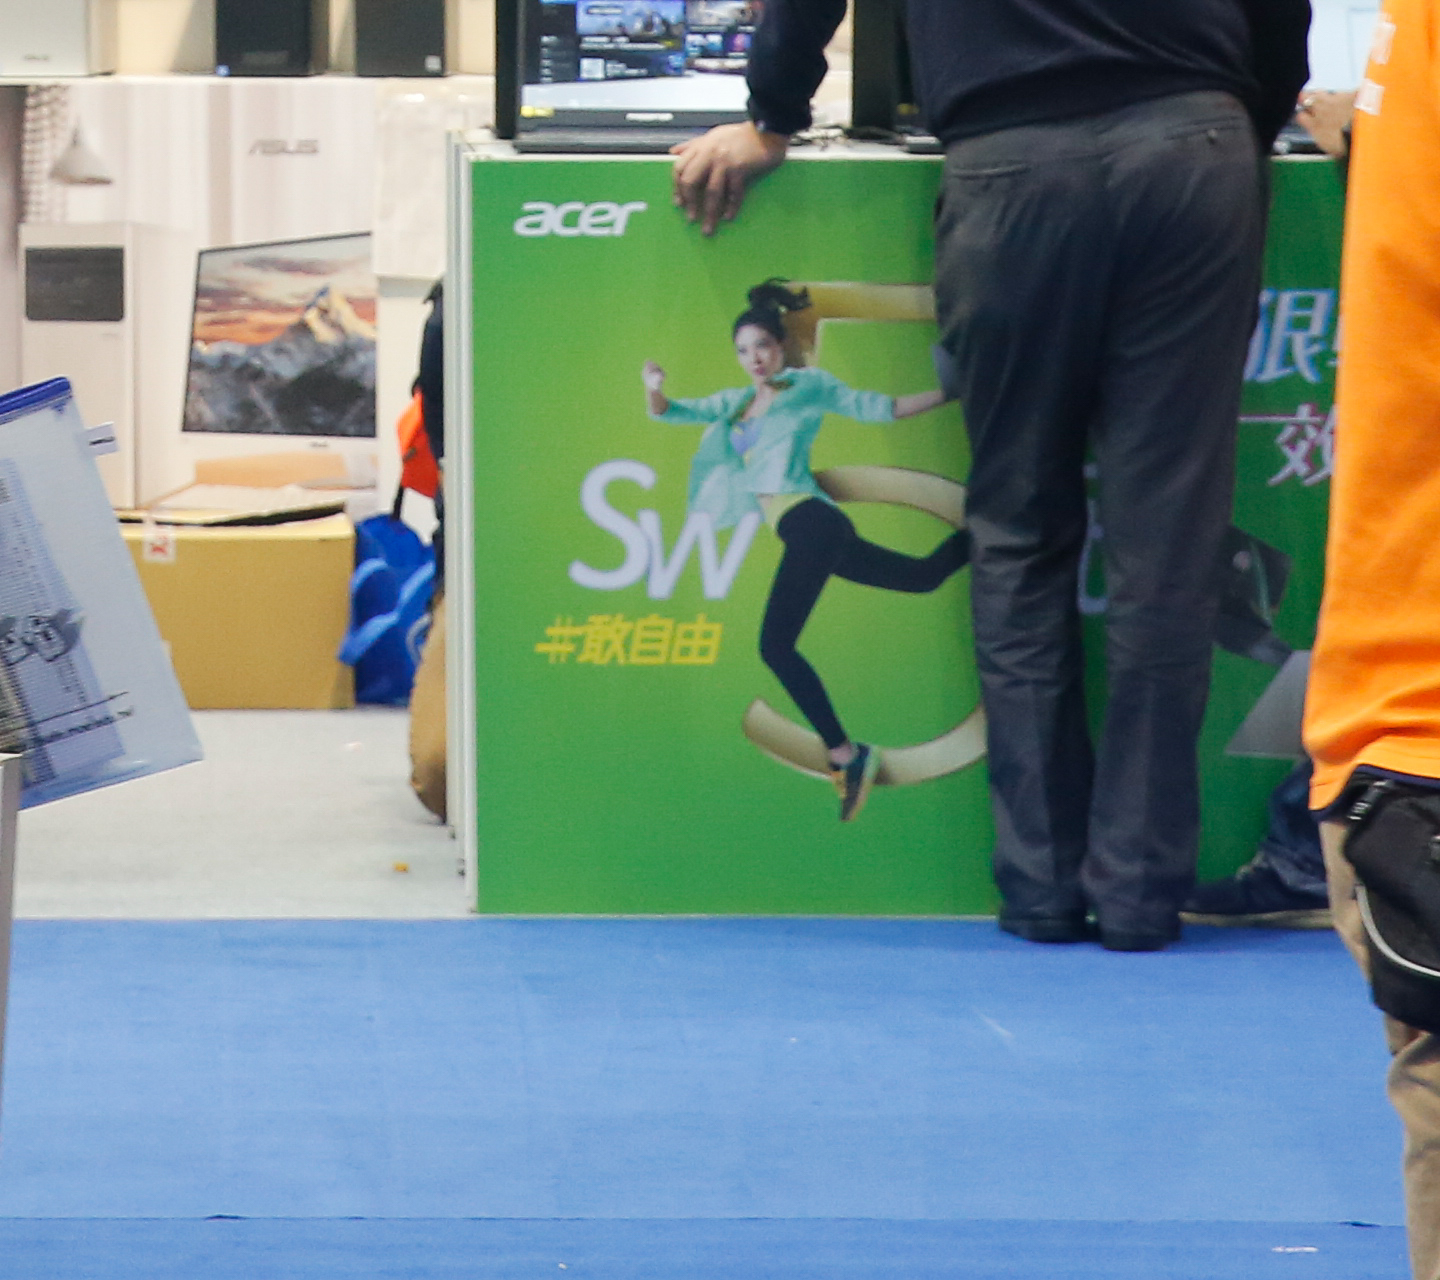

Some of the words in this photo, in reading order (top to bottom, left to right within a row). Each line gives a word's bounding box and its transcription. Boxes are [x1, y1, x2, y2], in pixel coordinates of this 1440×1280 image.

[248, 139, 319, 156] ASUS
[513, 200, 648, 237] acer
[534, 613, 724, 666] #敢自由
